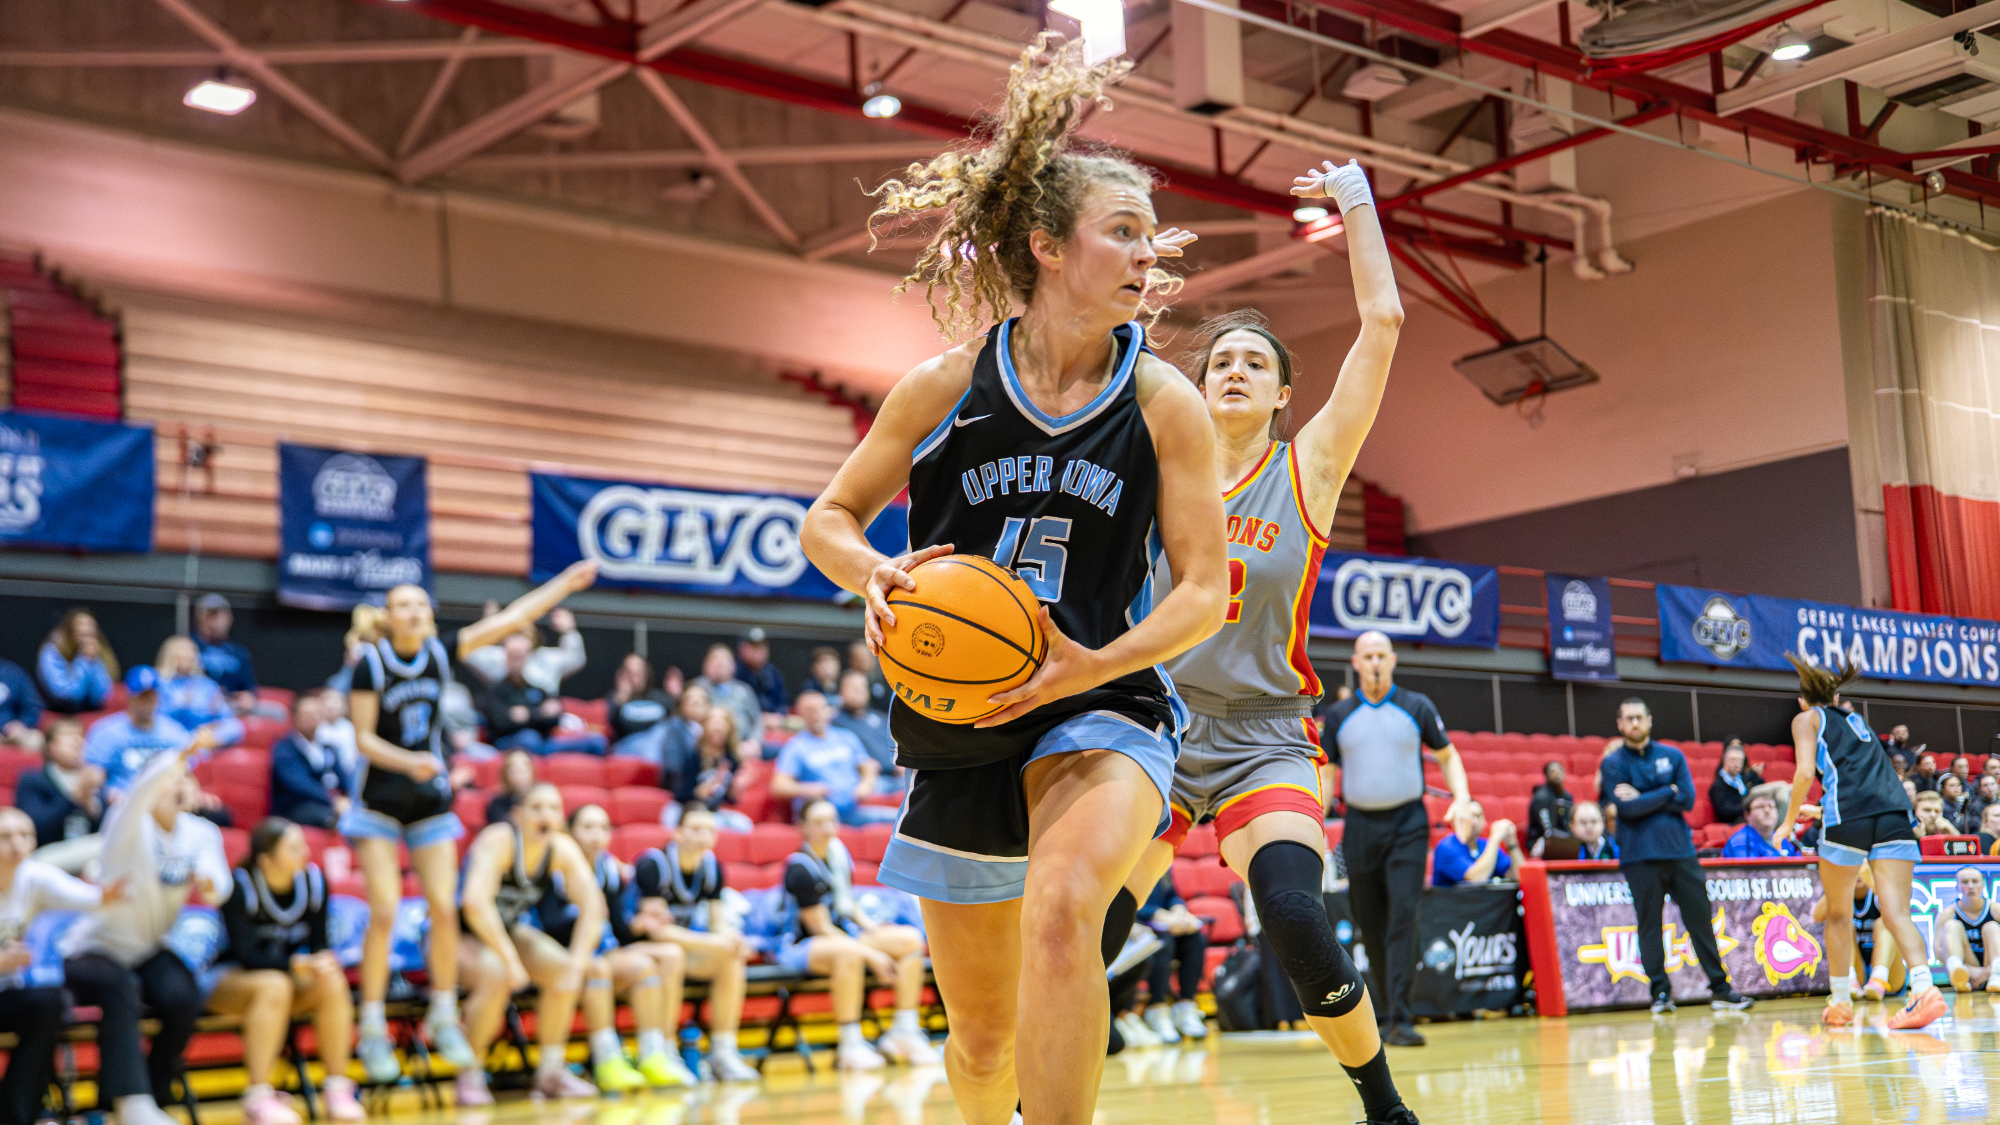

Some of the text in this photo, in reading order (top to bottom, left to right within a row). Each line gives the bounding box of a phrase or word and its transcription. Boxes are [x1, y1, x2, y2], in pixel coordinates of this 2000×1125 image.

[962, 455, 1124, 517] UPPER IOWA
[578, 485, 809, 588] GLVC
[993, 515, 1073, 603] 15
[1227, 514, 1281, 553] ONS
[1333, 558, 1472, 638] GLVC
[1797, 607, 2000, 643] GREAT LAKES VALLEY CONF
[1797, 626, 2000, 682] CHAMPIONS
[895, 681, 956, 712] EVO
[1565, 877, 1814, 907] UNIVERS SOURI ST. LOUIS
